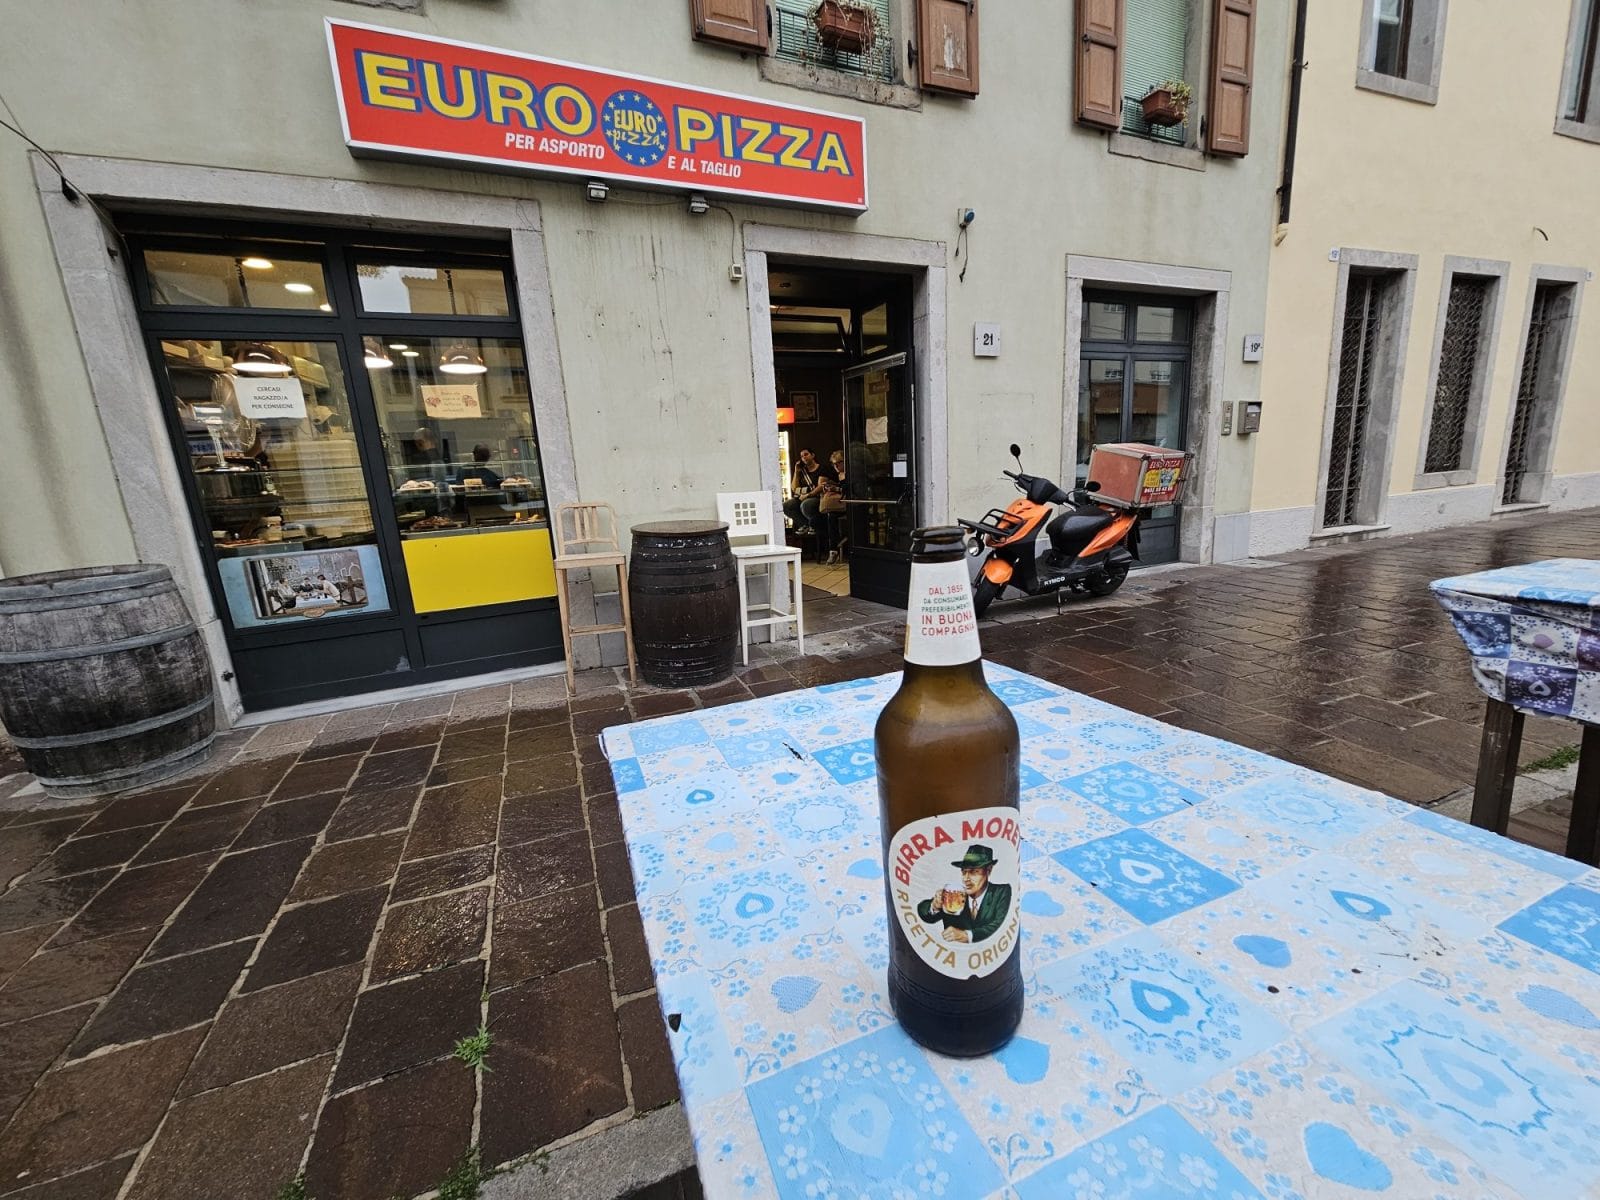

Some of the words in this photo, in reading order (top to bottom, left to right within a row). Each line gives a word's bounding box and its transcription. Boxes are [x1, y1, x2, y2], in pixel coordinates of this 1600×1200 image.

[356, 49, 596, 137] EURO
[613, 109, 657, 134] EURO
[505, 132, 535, 150] PER
[539, 137, 605, 160] ASPORTO
[612, 129, 661, 146] pizza
[675, 105, 852, 176] PIZZA
[668, 156, 677, 170] E
[680, 157, 697, 172] AL
[700, 160, 741, 178] TAGLIO
[983, 332, 994, 346] 21
[928, 587, 945, 596] DAL
[921, 614, 933, 625] IN
[938, 610, 973, 625] BUONA
[921, 623, 975, 637] COMPAGNIA
[895, 826, 955, 887] BIRRA
[961, 816, 1020, 848] MORE
[896, 888, 957, 969] RICETTA
